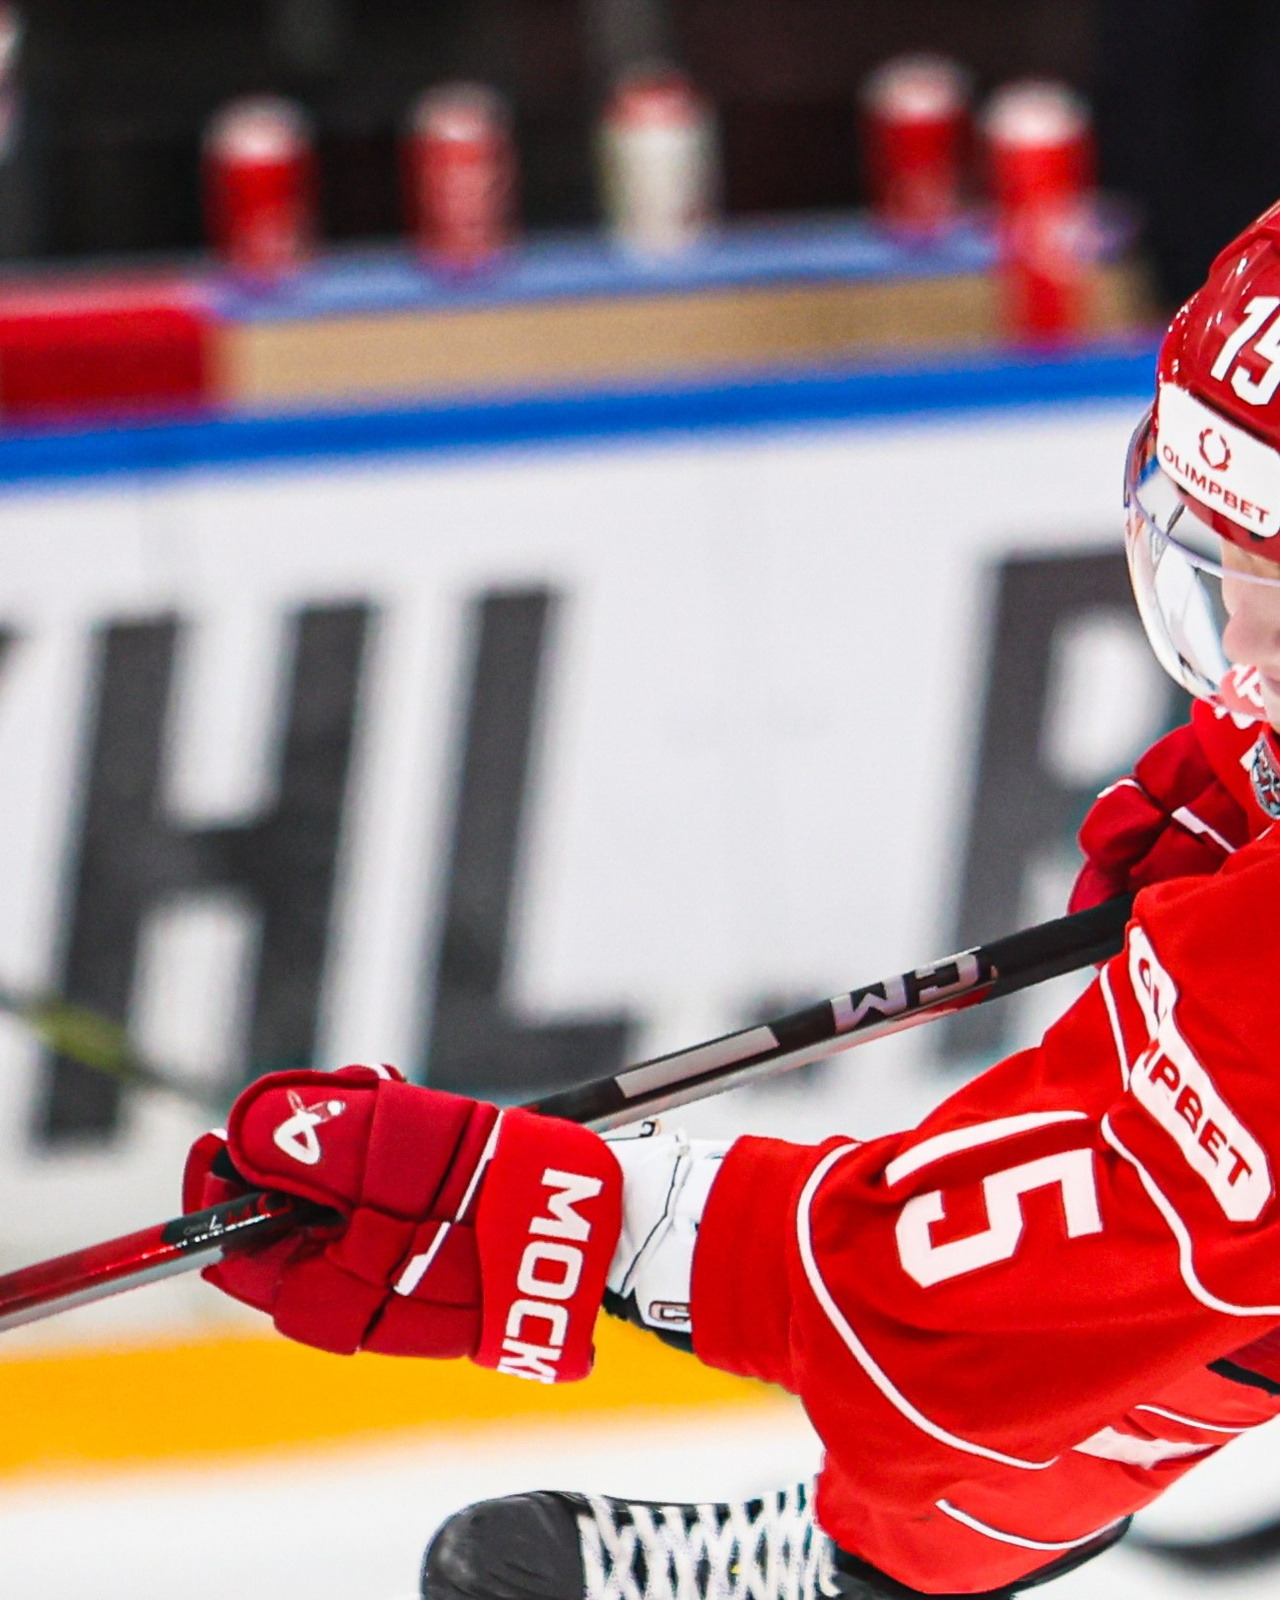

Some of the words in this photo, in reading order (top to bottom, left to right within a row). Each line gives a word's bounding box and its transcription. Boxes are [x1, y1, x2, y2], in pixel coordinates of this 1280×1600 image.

[1162, 444, 1270, 525] OLIMPBET
[496, 1166, 605, 1385] МОСК
[885, 1109, 1103, 1290] 15
